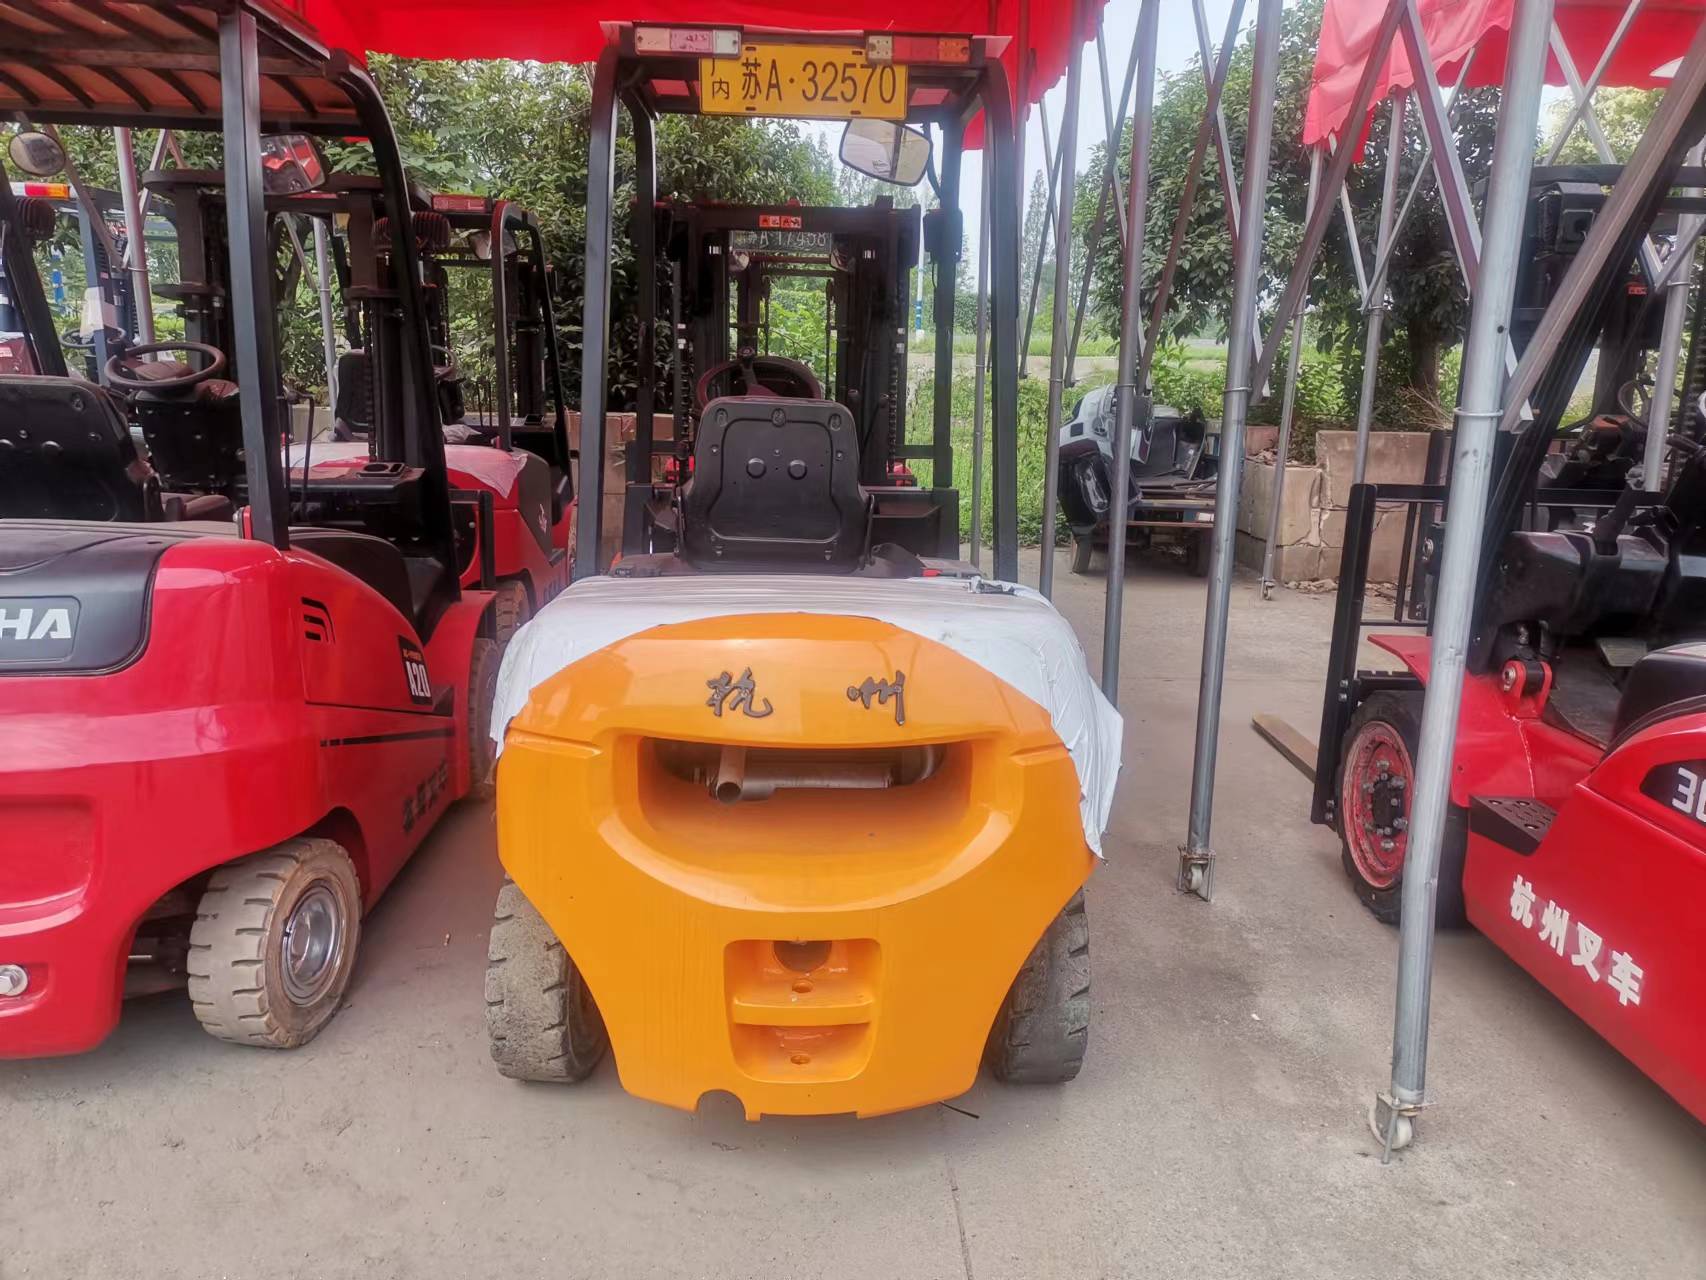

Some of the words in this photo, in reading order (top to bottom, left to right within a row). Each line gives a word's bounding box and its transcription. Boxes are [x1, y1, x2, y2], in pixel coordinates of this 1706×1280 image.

[741, 57, 897, 104] 苏A·32570
[0, 608, 72, 640] HA
[1510, 874, 1644, 1007] 杭州叉车
